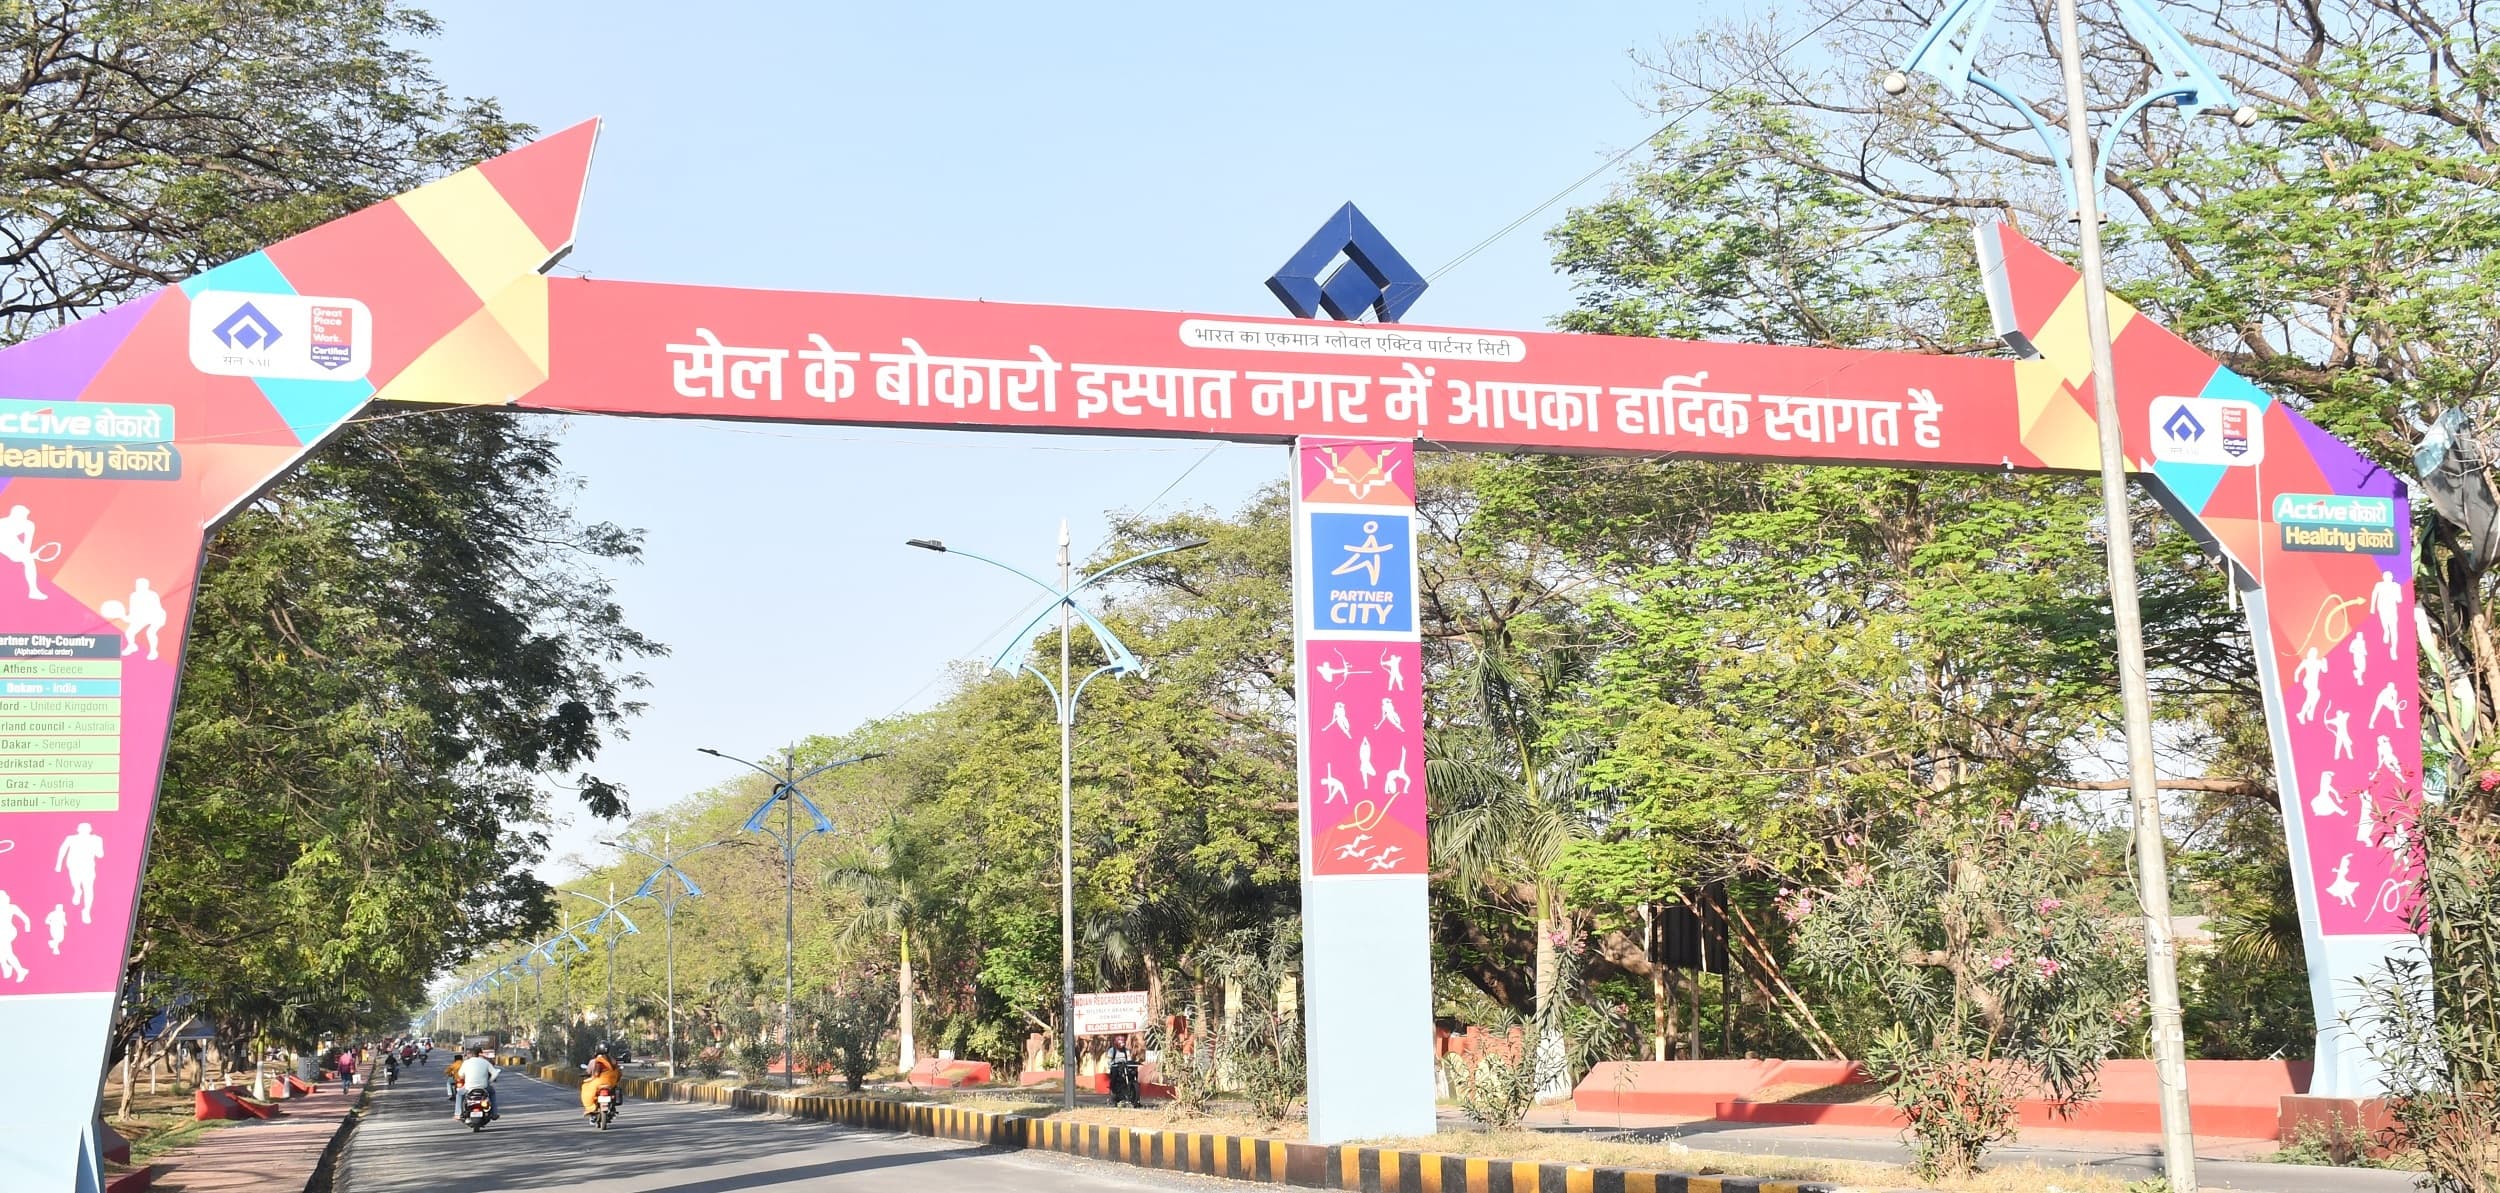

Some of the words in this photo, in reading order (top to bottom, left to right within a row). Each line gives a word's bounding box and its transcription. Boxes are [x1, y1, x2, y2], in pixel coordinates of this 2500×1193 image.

[313, 308, 342, 317] Great
[313, 316, 342, 325] Place
[313, 325, 324, 333] To
[1195, 327, 1234, 343] भारत
[1240, 330, 1259, 344] का
[1265, 331, 1319, 347] एकमात्र
[1377, 334, 1422, 352] एक्टिव
[1427, 336, 1473, 355] पार्टनर
[1477, 338, 1511, 357] सिटी
[666, 327, 789, 402] सेल
[798, 333, 861, 403] के
[869, 337, 1063, 413] बोकारो
[1070, 362, 1238, 420] इस्पात
[1246, 369, 1372, 426] नगर
[1380, 363, 1435, 426] में
[1448, 379, 1602, 433] आपका
[1609, 372, 1751, 438] हार्दिक
[1758, 393, 1900, 448] स्वागत
[1906, 387, 1943, 449] है
[0, 408, 92, 435] ctive
[95, 408, 162, 439] बोकारो
[108, 445, 173, 472] बोकारो
[2277, 498, 2347, 521] Active
[2349, 501, 2388, 523] बोकारो
[2285, 526, 2356, 552] Healthy
[2357, 528, 2394, 549] बोकारो
[1331, 590, 1393, 602] PARTNER
[1330, 602, 1394, 624] CITY
[0, 635, 30, 646] artner
[31, 635, 96, 649] City-Country
[3, 663, 38, 674] Athens
[48, 663, 83, 674] Greece
[30, 700, 62, 711] United
[64, 700, 108, 713] Kingdom
[29, 721, 65, 731] council
[74, 721, 115, 732] Australia
[1, 739, 31, 749] Dakar
[42, 739, 81, 751] Senegal
[0, 758, 45, 768] edrikstad
[55, 758, 94, 770] Norway
[6, 779, 29, 789] Graz
[39, 779, 74, 789] Austria
[0, 797, 39, 808] stanbul
[50, 797, 81, 810] Turkey
